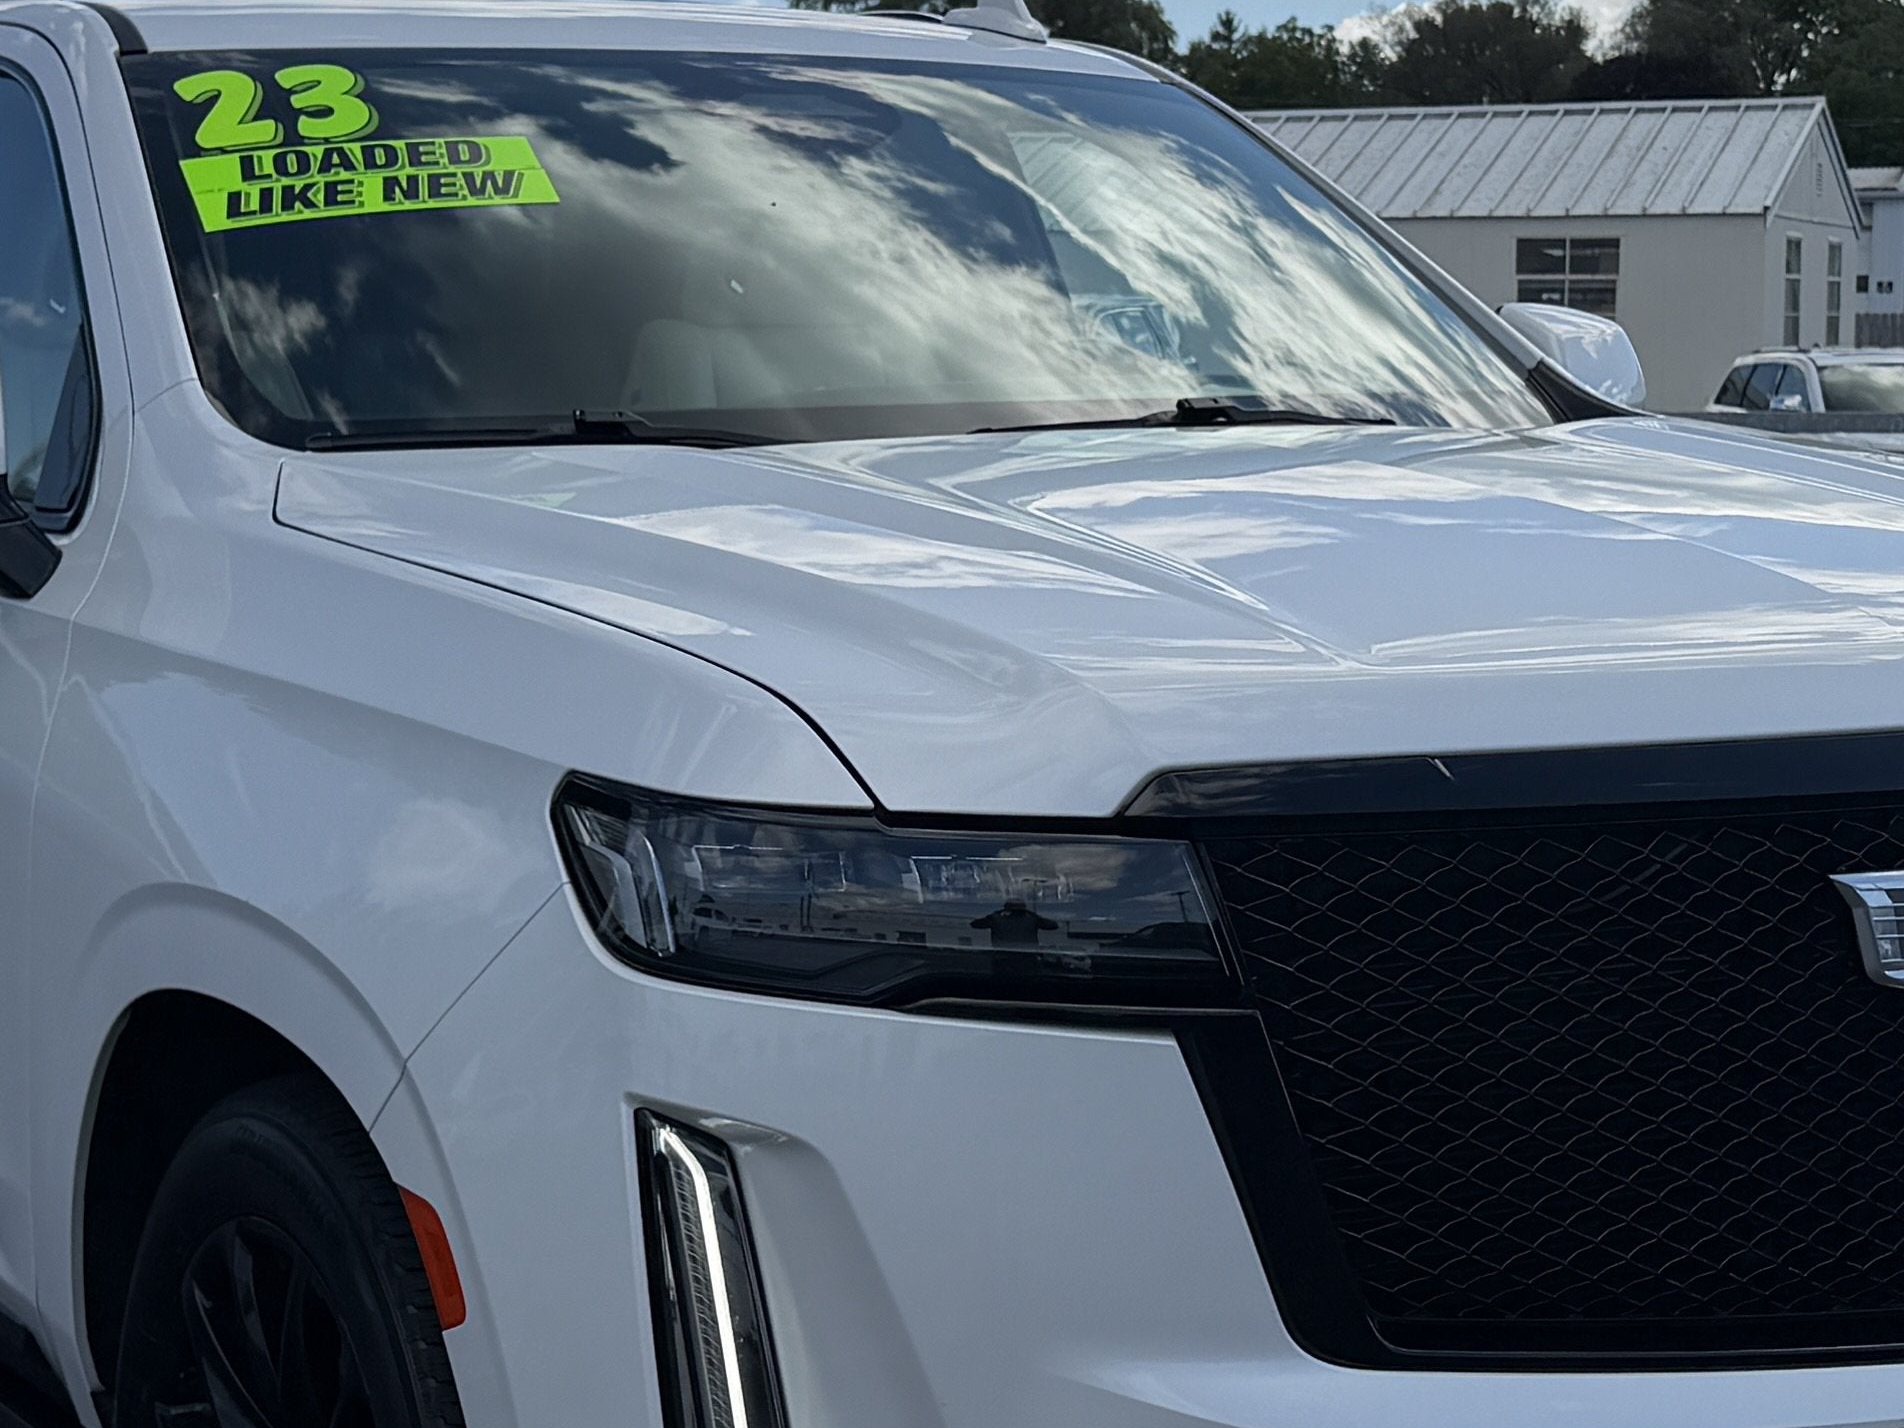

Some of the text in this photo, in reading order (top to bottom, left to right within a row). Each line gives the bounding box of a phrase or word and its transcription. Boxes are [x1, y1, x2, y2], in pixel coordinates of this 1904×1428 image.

[173, 63, 379, 152] 23
[238, 139, 489, 185] LOADED
[226, 169, 523, 220] LIKE NEW
